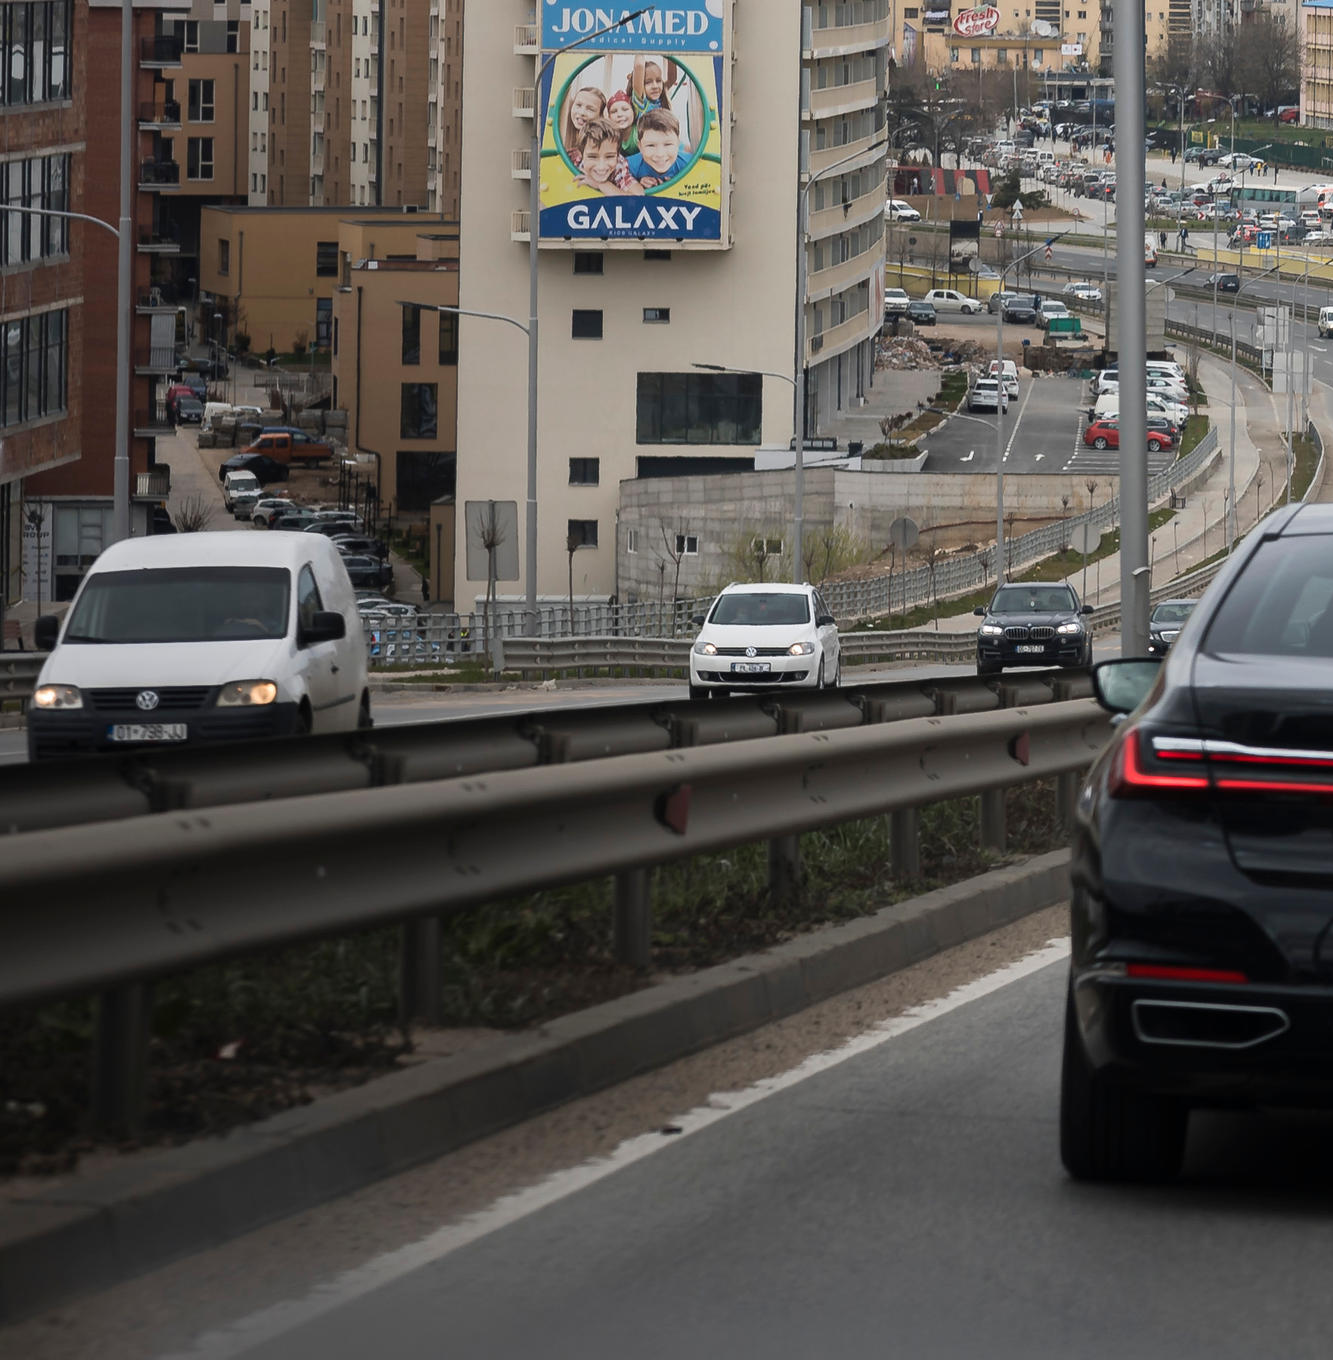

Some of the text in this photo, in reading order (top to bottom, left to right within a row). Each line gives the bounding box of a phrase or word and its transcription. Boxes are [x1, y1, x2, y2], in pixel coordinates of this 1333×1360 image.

[552, 7, 709, 36] JONAMED
[959, 7, 994, 23] Fresh
[965, 20, 991, 34] Store
[581, 36, 632, 44] edical
[567, 205, 702, 231] GALAXY
